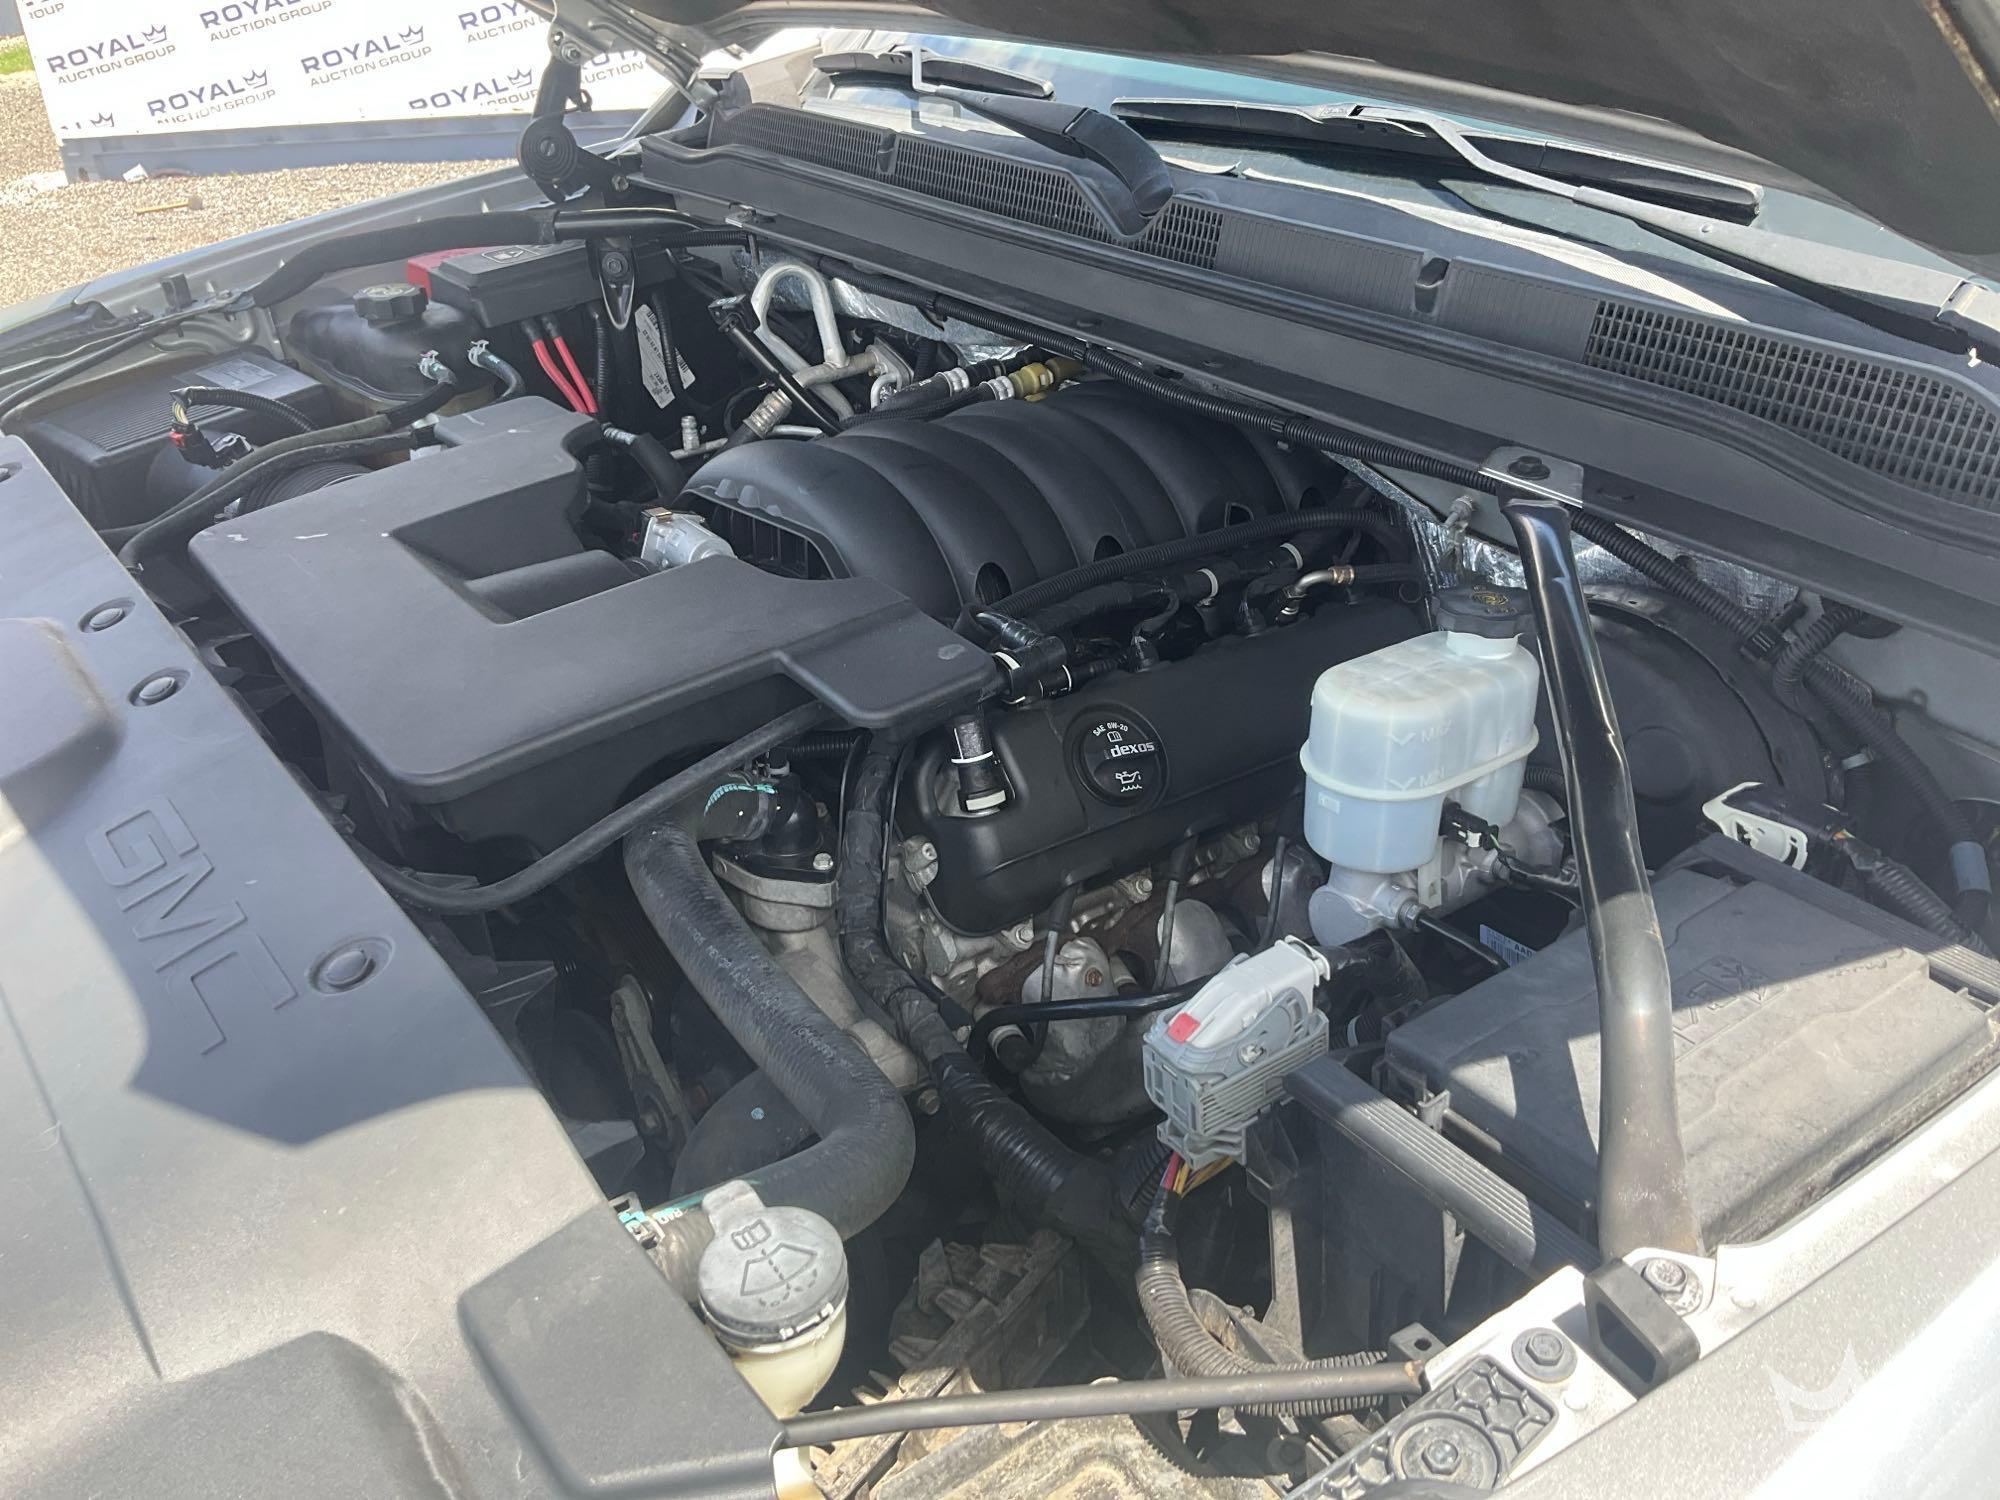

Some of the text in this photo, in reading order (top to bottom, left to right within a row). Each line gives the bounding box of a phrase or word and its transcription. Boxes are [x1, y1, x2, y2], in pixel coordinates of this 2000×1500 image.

[210, 0, 332, 42] AUCTION GROUP
[467, 17, 535, 43] AUCTION
[47, 35, 145, 73] ROYAL
[58, 45, 176, 84] AUCTION GROUP
[300, 35, 401, 74] ROYAL
[310, 46, 432, 87] AUCTION GROUP
[580, 61, 644, 84] UCTION
[147, 79, 246, 117] ROYAL
[224, 89, 276, 111] GROUP
[1092, 724, 1106, 737] SAE
[1110, 742, 1155, 758] dexos
[85, 797, 298, 1055] GMC
